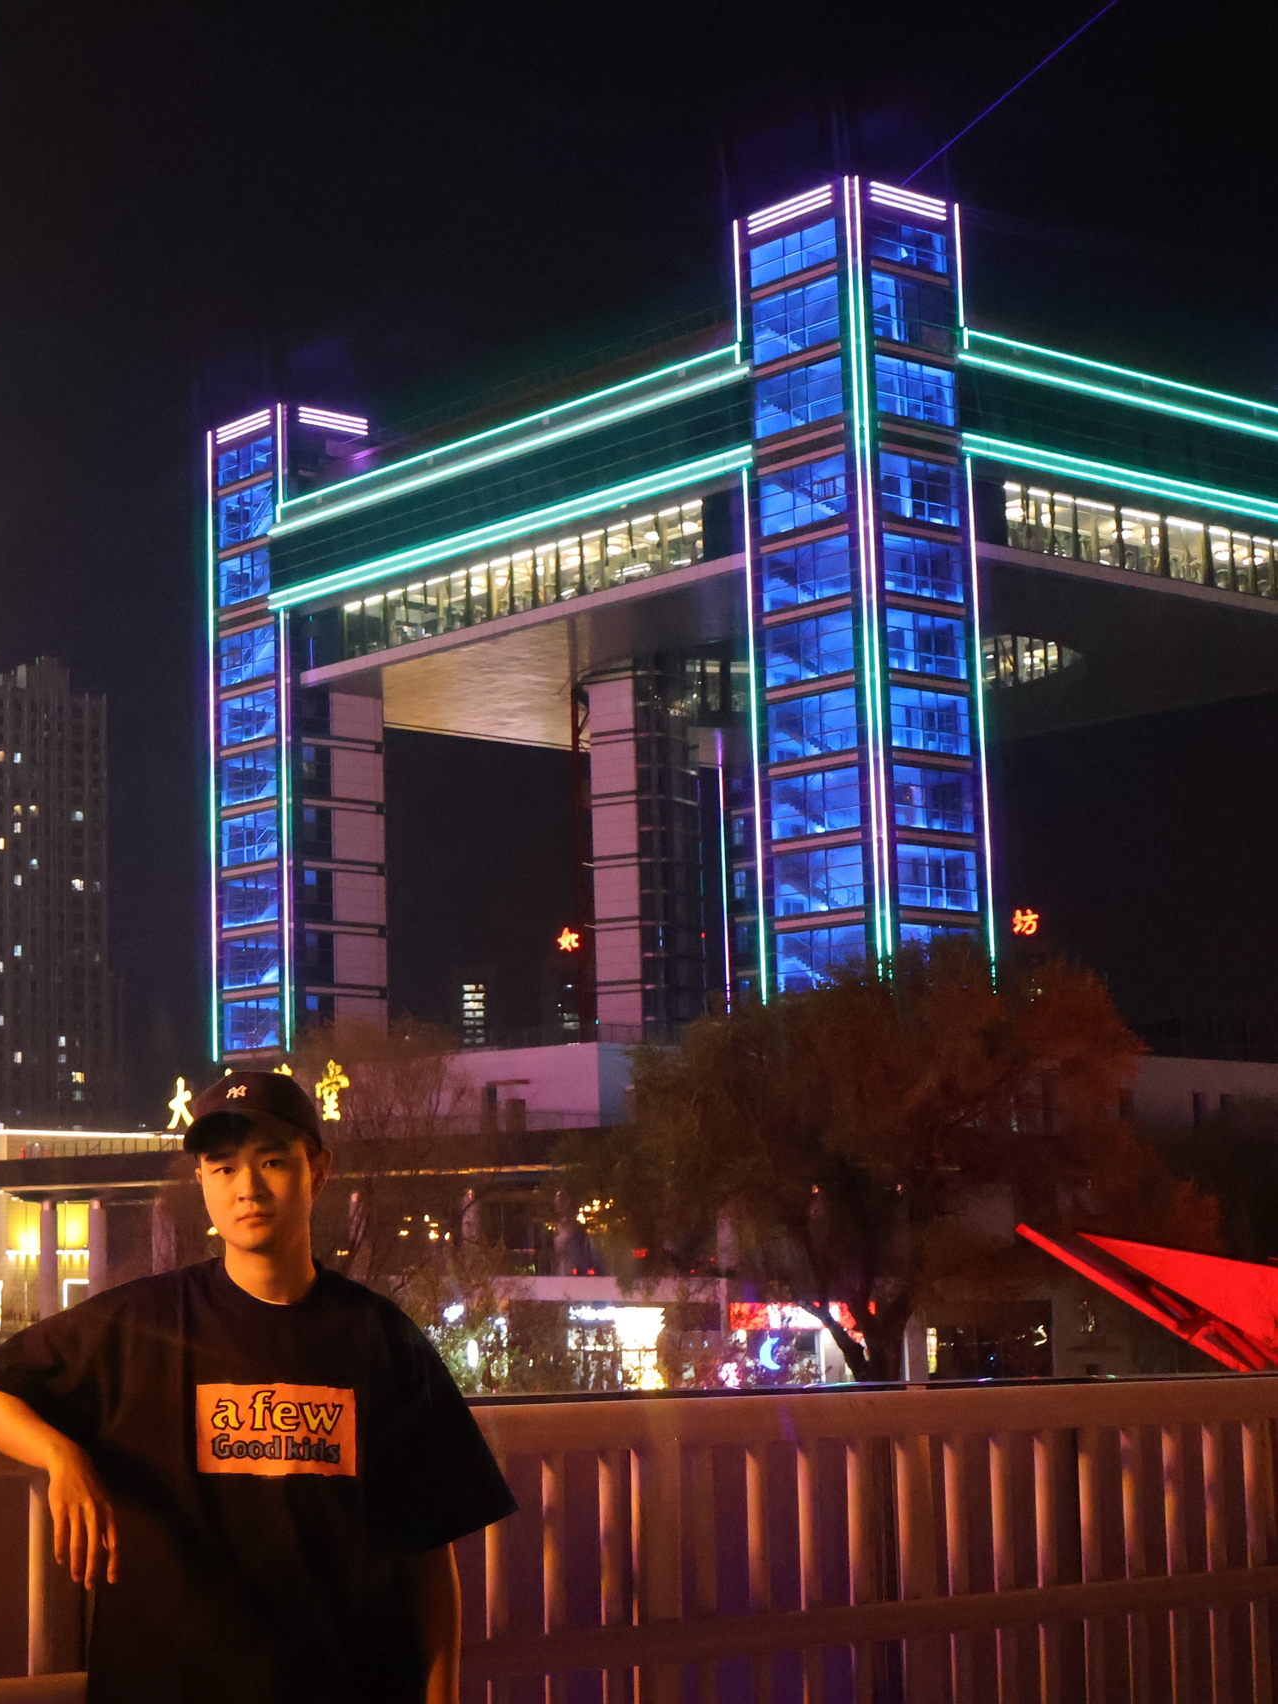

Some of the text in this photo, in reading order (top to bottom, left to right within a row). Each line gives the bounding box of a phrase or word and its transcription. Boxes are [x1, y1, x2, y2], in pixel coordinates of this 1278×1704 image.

[249, 1390, 343, 1435] few
[211, 1433, 341, 1464] Good kids
